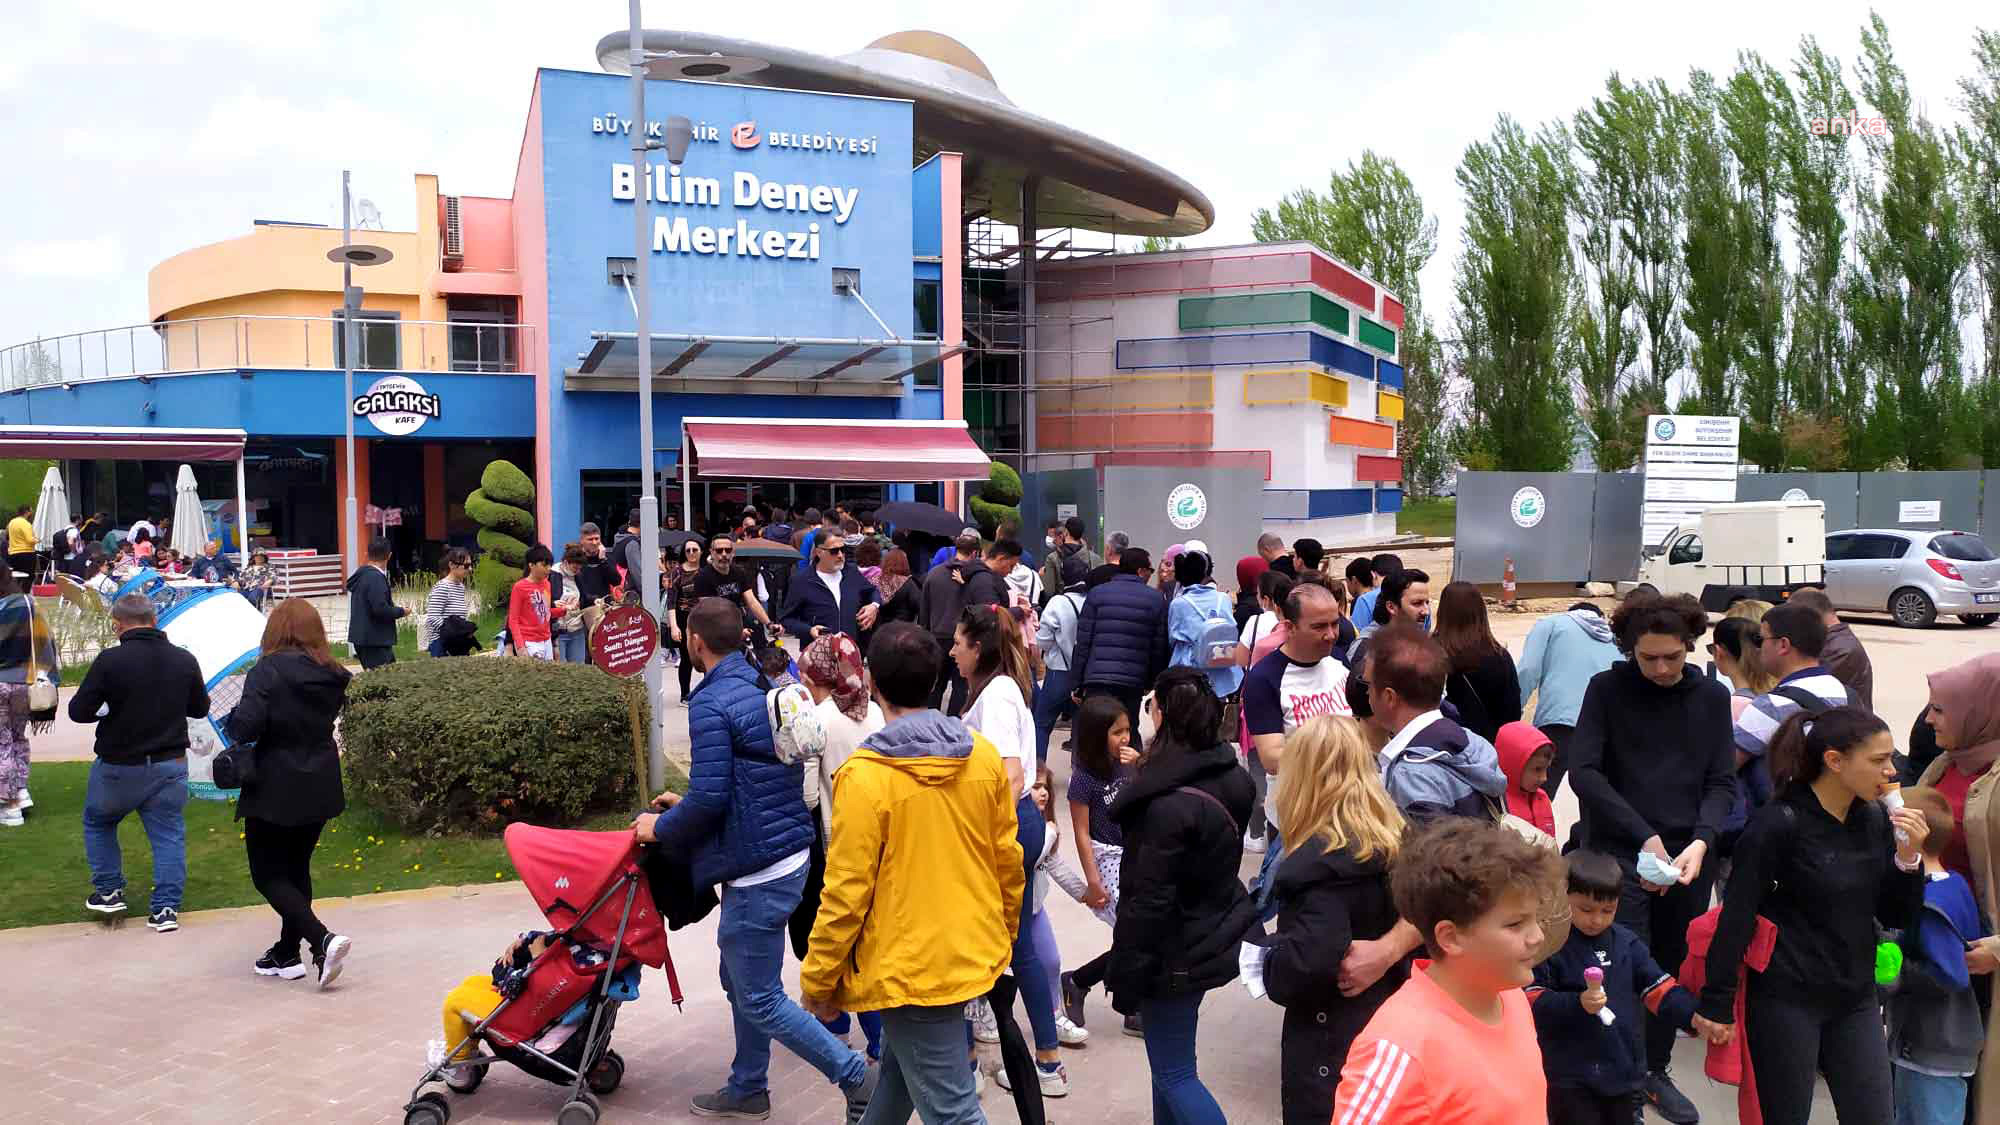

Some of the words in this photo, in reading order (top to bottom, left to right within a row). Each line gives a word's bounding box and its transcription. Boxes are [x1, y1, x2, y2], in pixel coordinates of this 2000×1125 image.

[592, 112, 719, 141] BÜYKHİR
[769, 131, 877, 154] BELEDİYESİ
[733, 171, 859, 223] Deney
[652, 216, 820, 260] Merkezi
[353, 392, 440, 417] GALAKSİ
